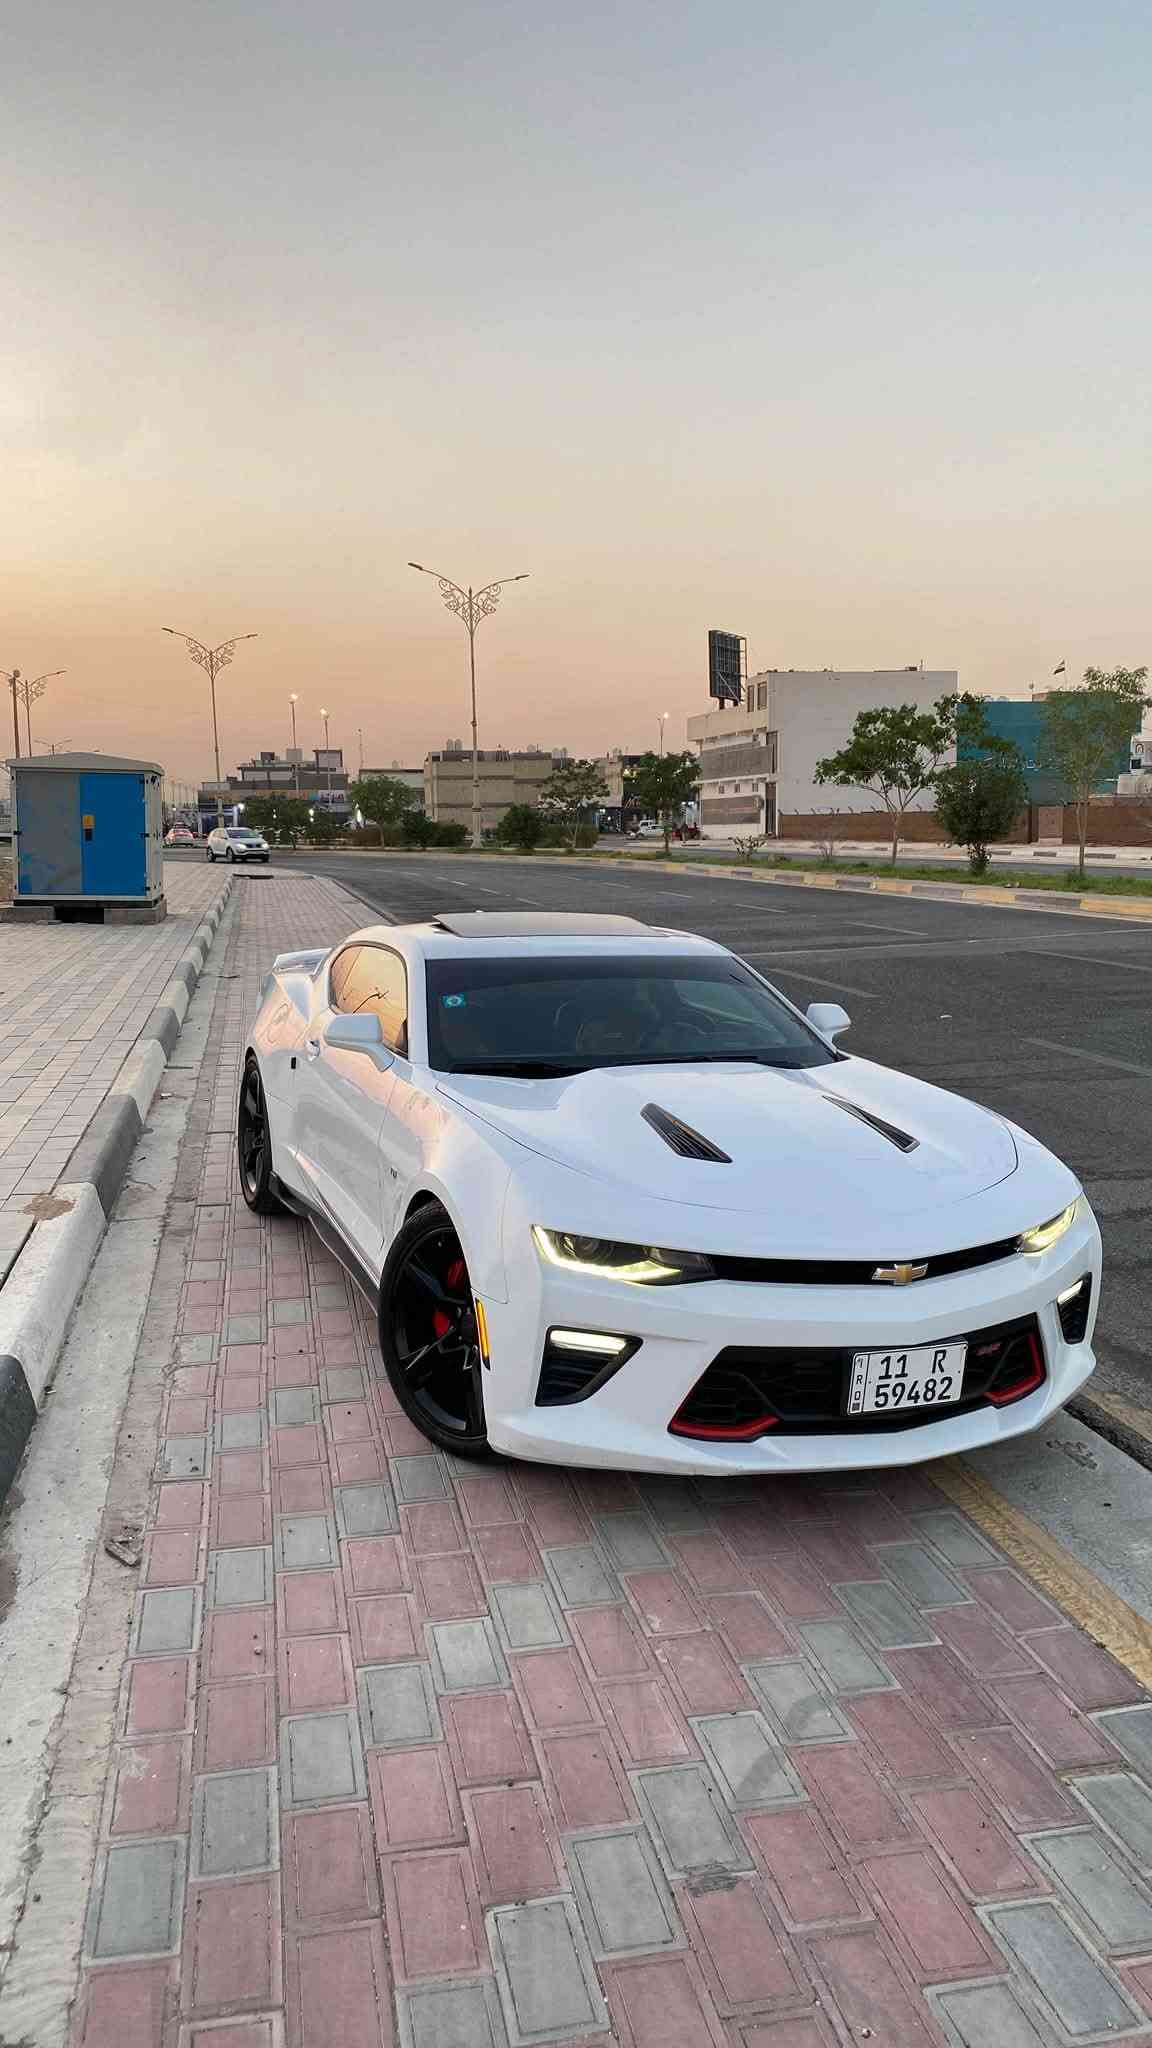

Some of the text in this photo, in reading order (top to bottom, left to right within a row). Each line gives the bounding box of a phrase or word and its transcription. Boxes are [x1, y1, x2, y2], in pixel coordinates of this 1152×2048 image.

[878, 1354, 908, 1380] 11
[931, 1349, 947, 1374] R
[874, 1376, 953, 1408] 59482
